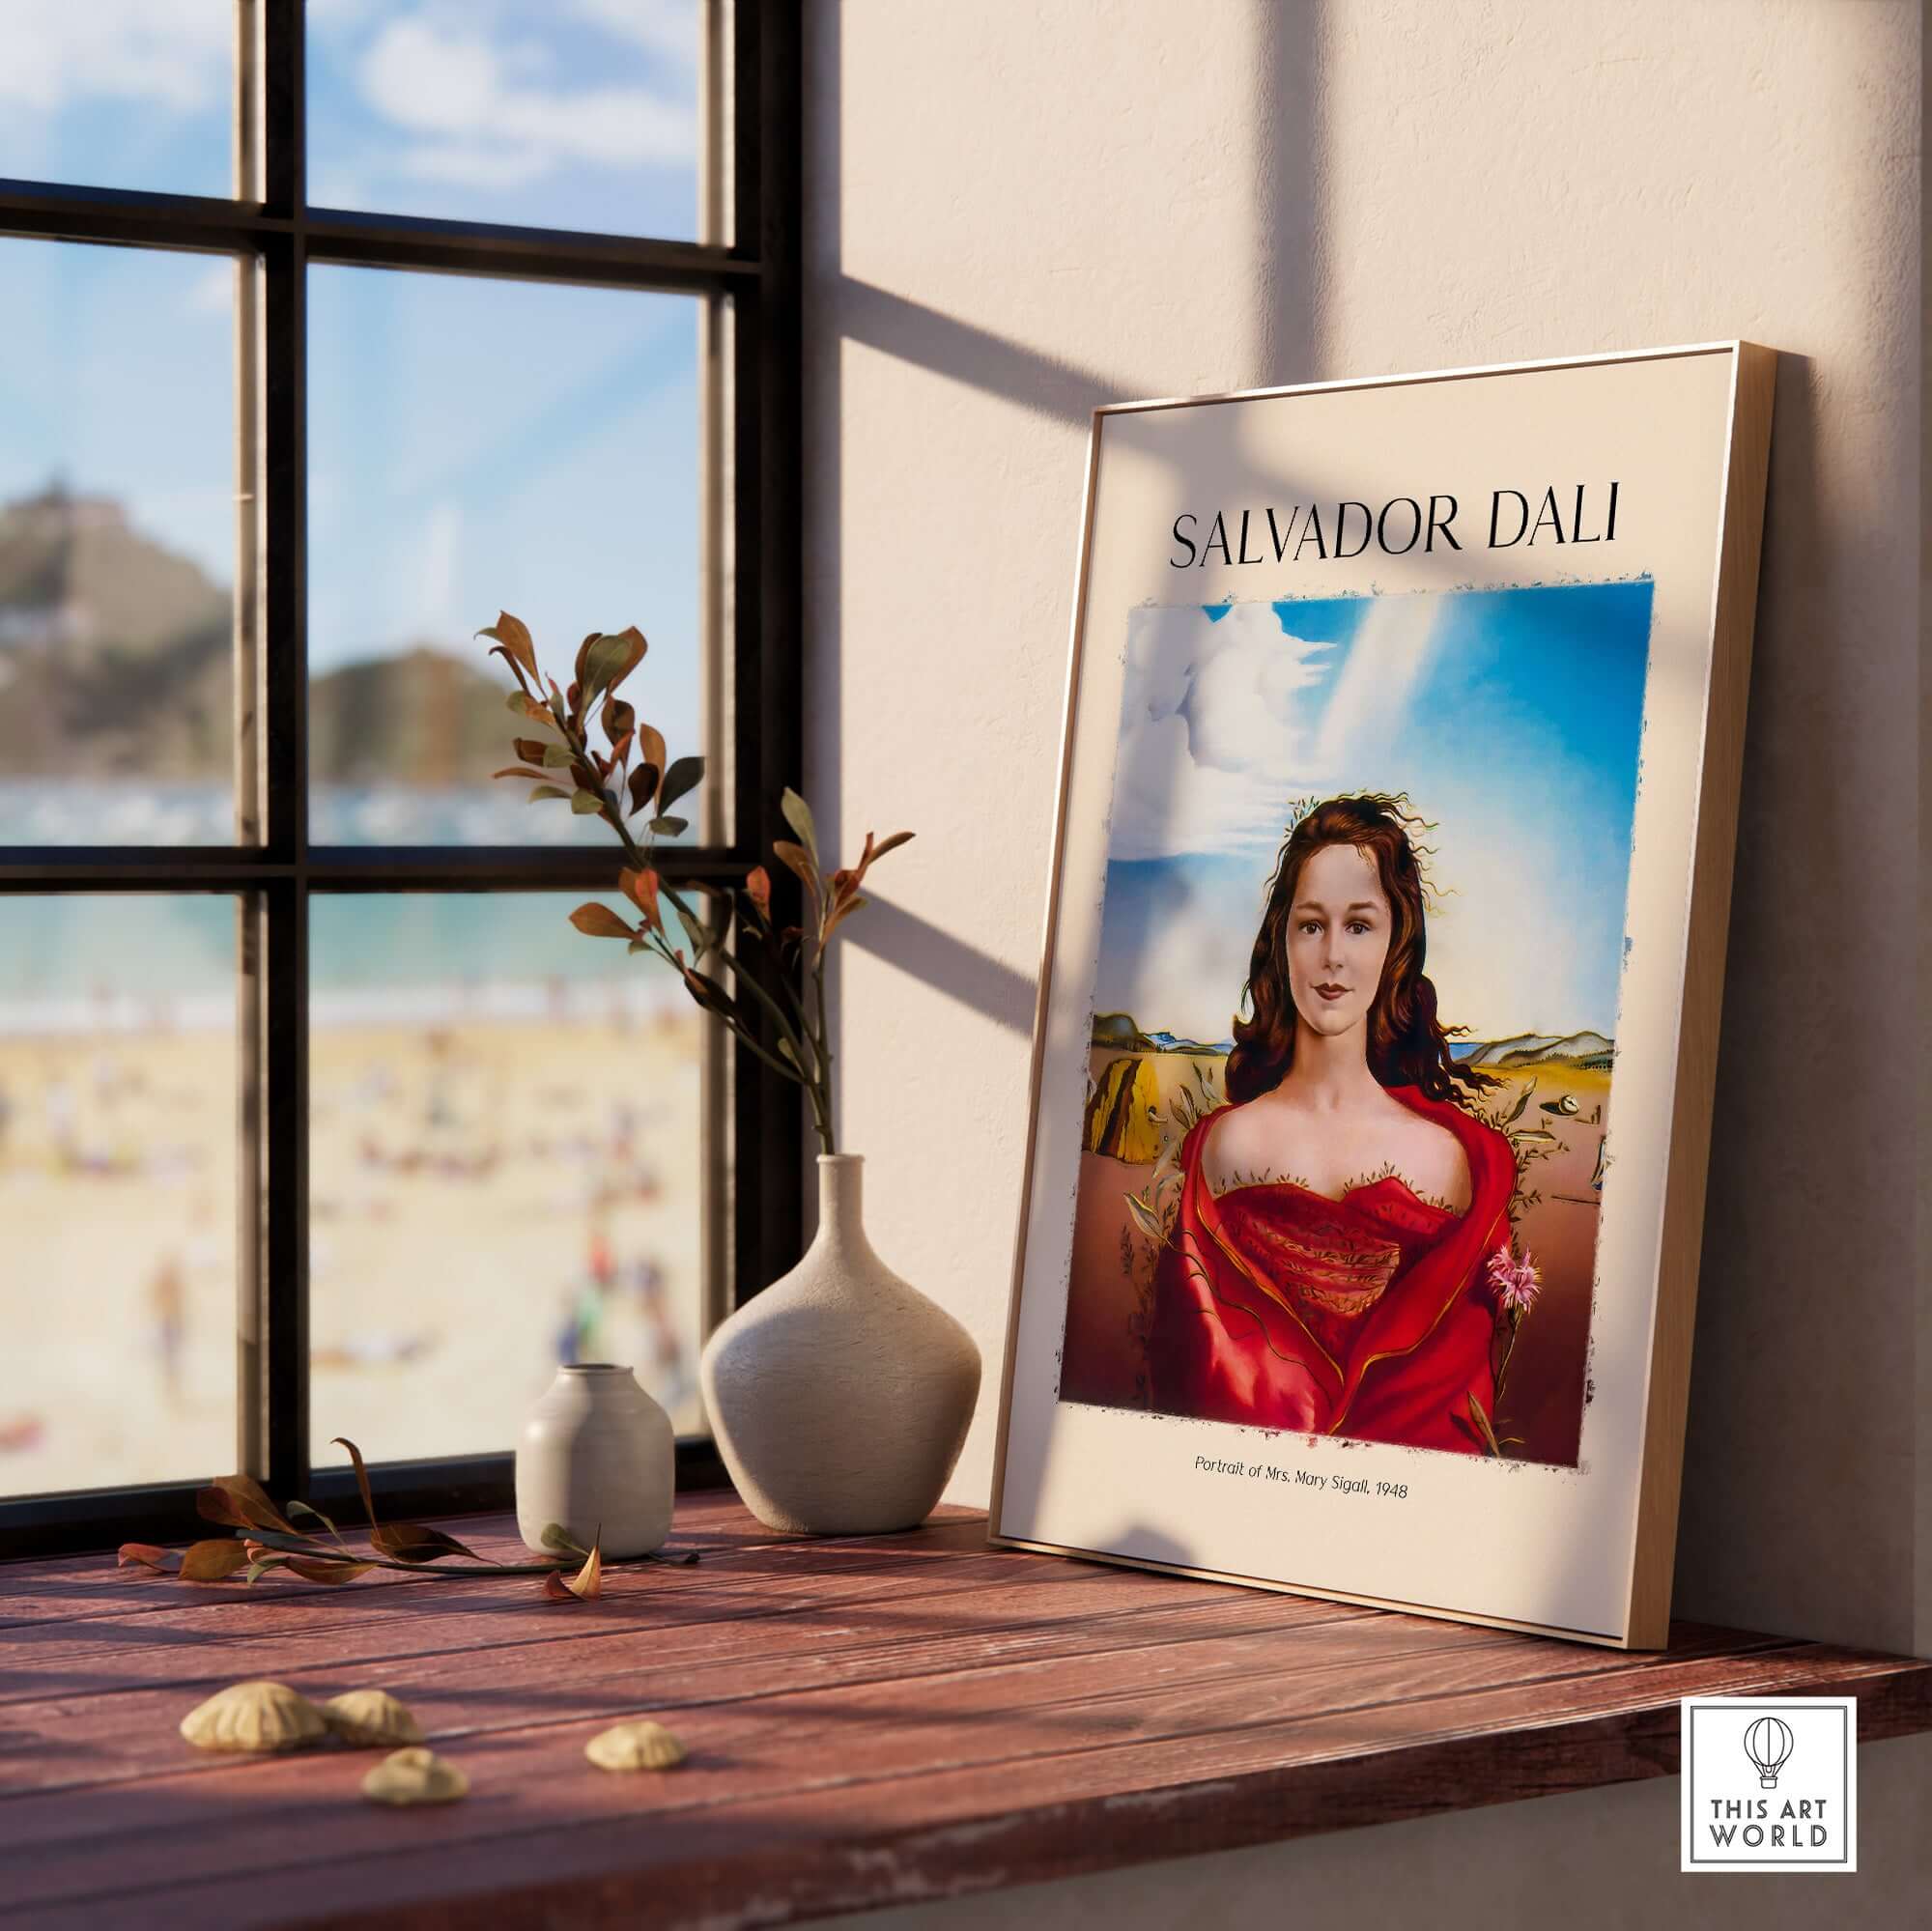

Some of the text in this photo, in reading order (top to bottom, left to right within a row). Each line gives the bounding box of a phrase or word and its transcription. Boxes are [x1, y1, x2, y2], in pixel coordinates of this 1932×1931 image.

[1170, 481, 1621, 569] SALVADOR DALI
[1194, 1456, 1408, 1499] Portrait of Mrs. Mary Sigall, 1948
